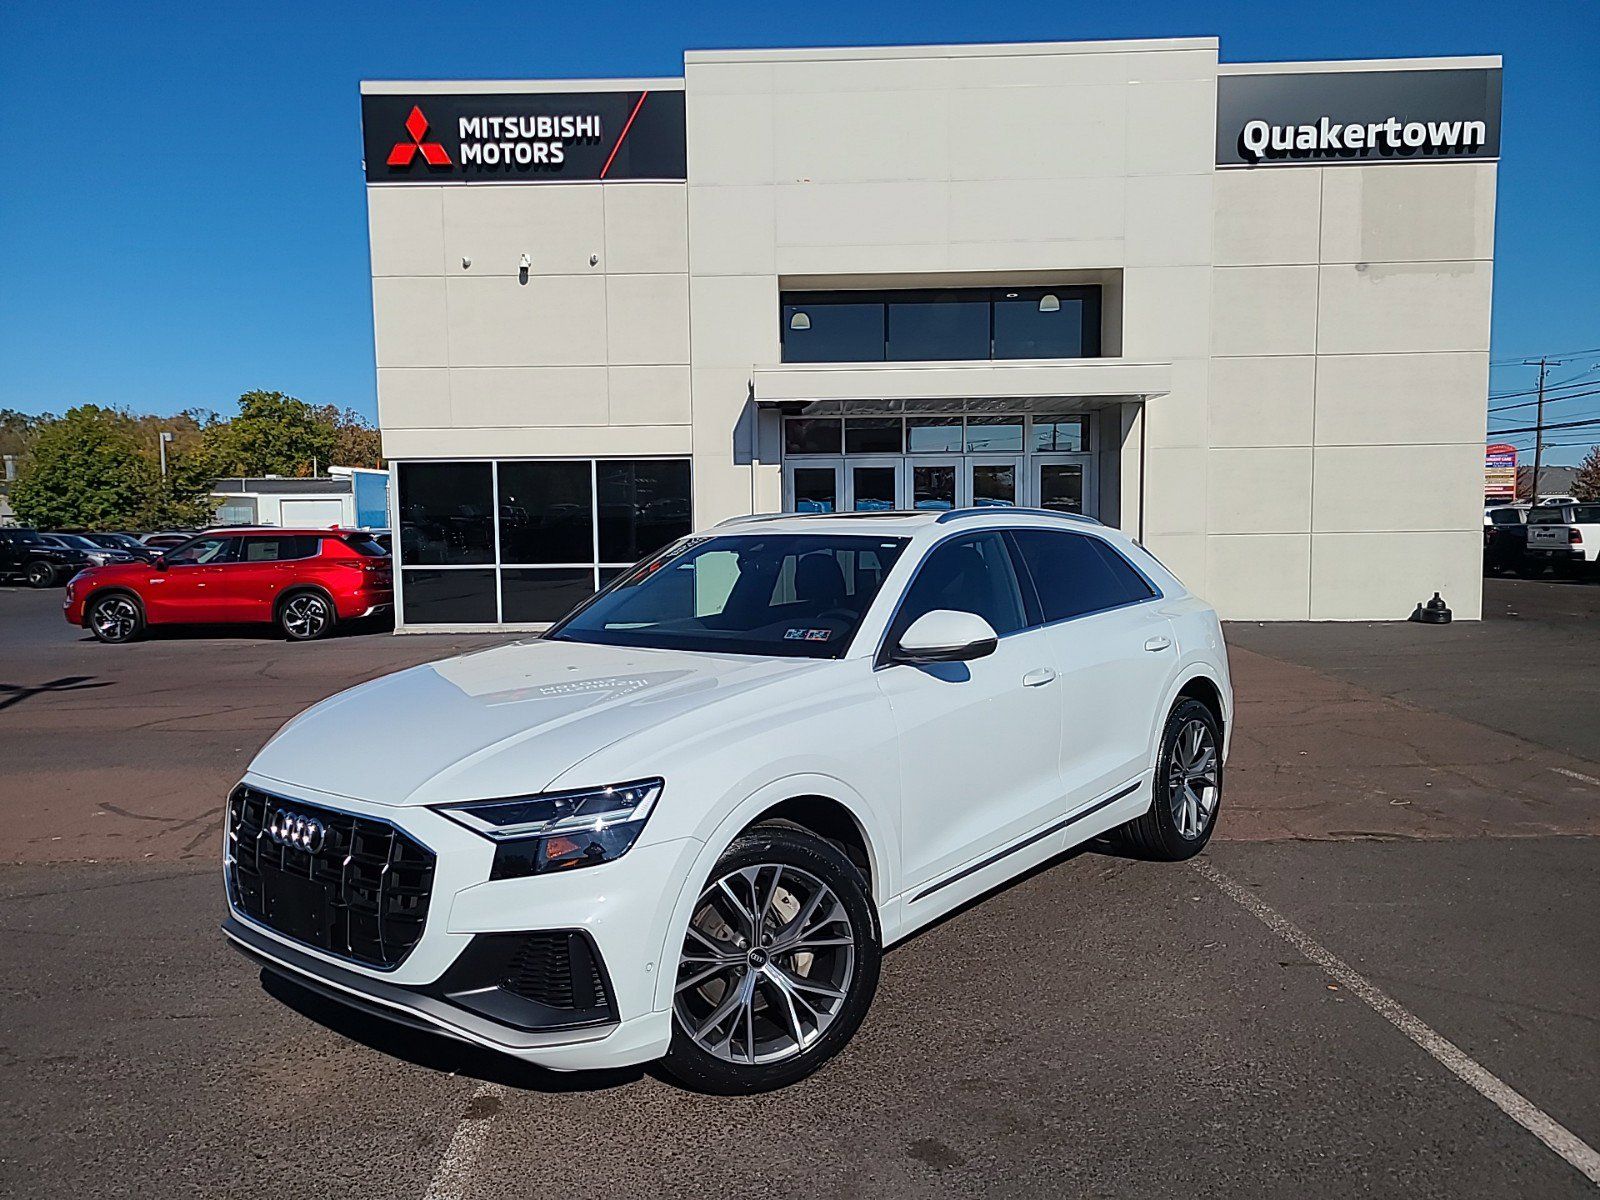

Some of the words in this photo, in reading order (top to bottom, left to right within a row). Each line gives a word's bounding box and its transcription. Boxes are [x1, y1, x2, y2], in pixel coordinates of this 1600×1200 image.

[459, 115, 600, 139] MITSUBISHI
[1243, 116, 1486, 157] Quakertown
[460, 142, 564, 165] MOTORS
